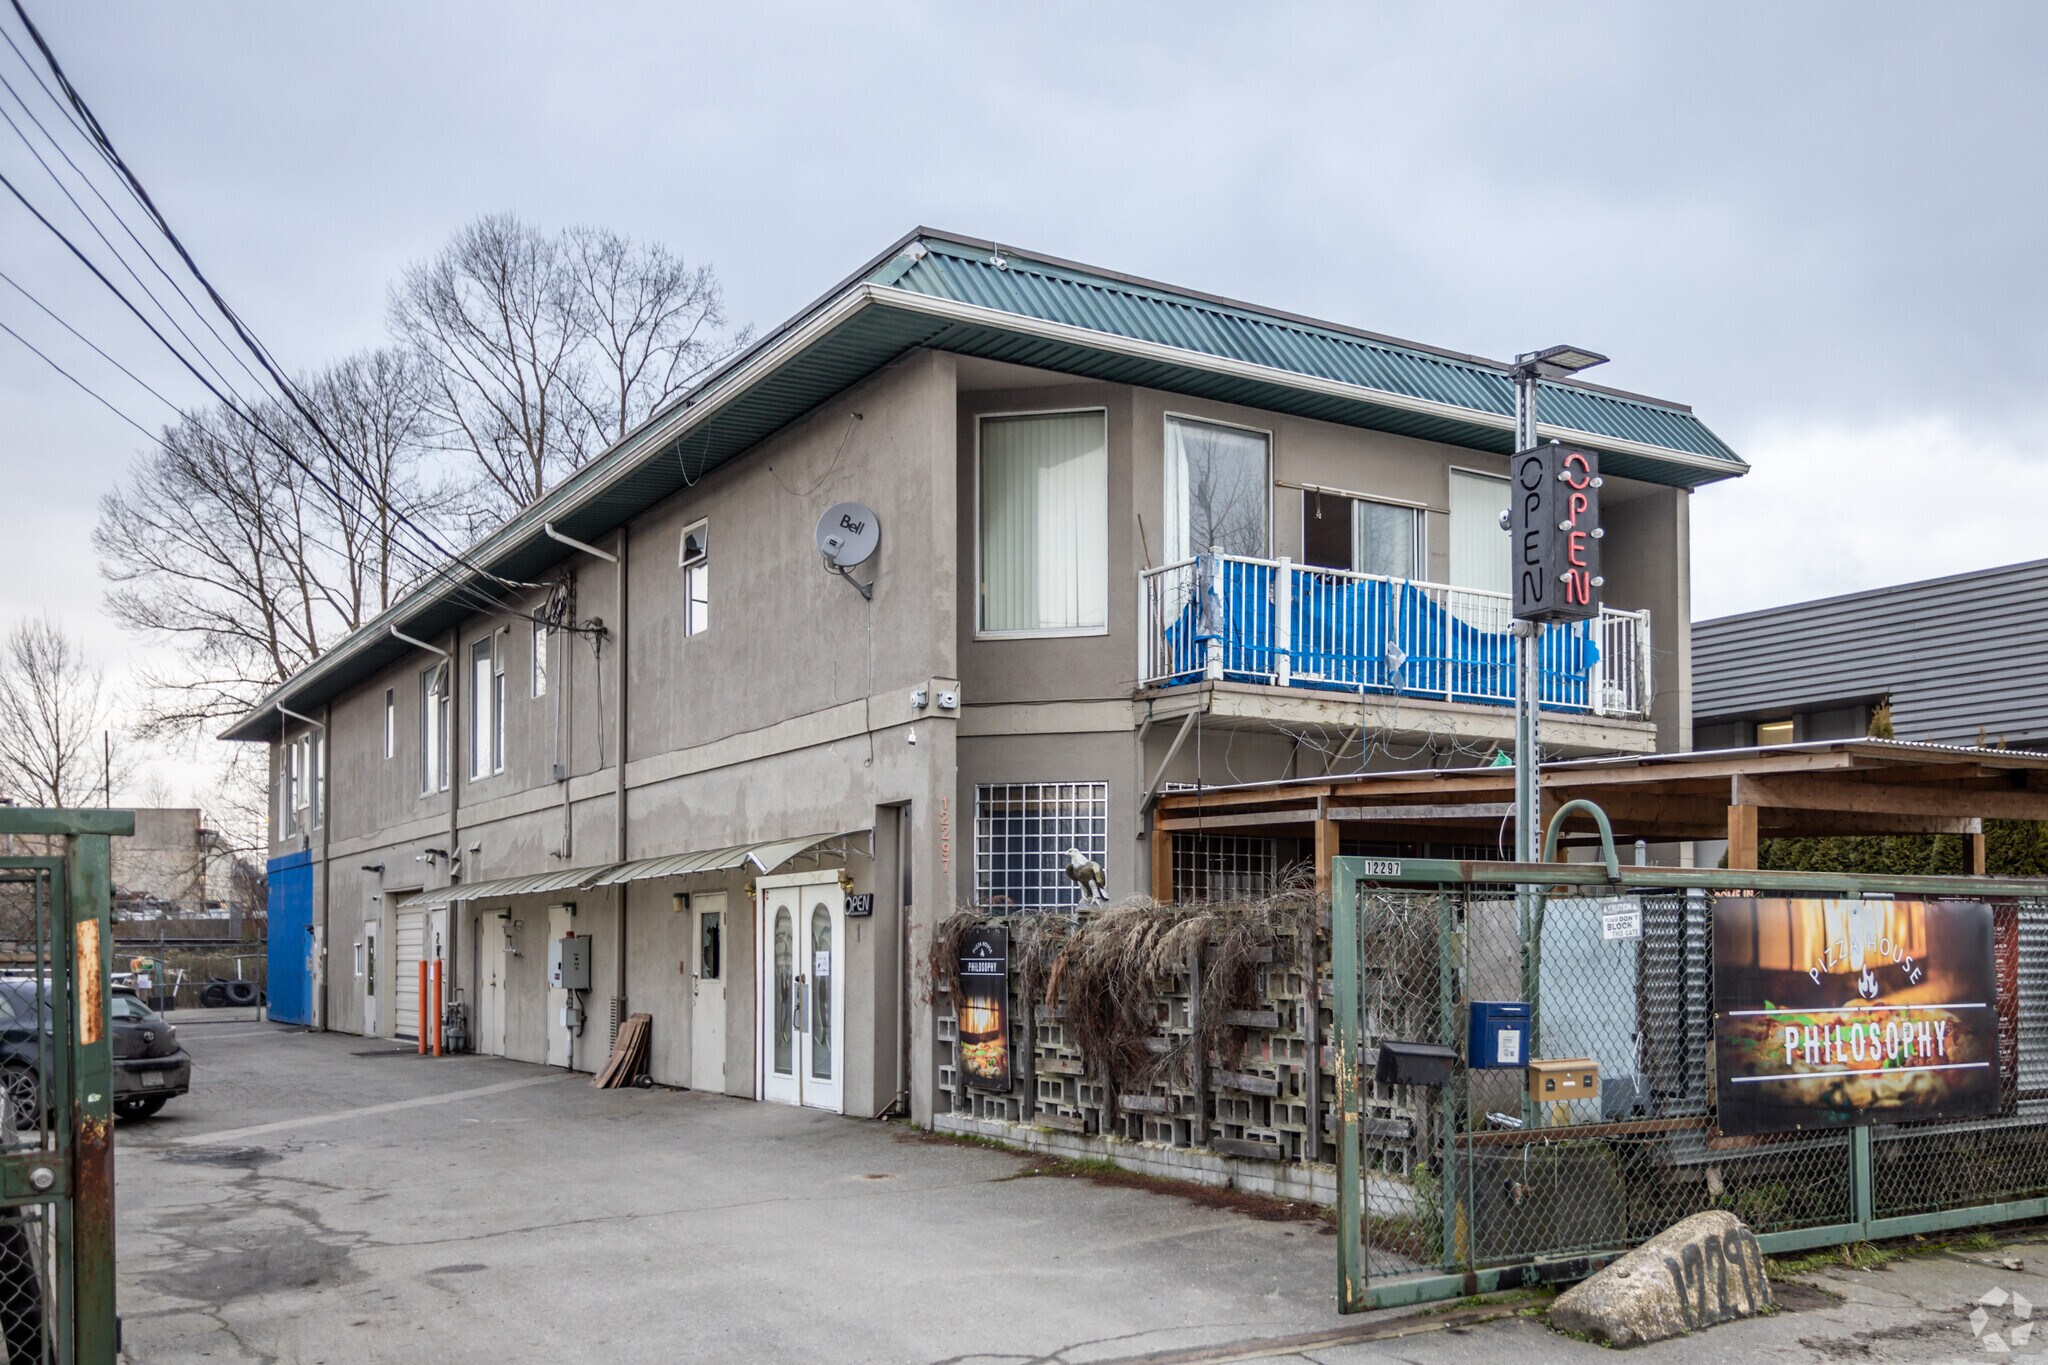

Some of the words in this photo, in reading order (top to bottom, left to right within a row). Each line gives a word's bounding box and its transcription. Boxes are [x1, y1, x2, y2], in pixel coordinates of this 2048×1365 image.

[839, 513, 866, 536] Bell
[1520, 456, 1543, 605] OPEN
[1563, 453, 1590, 605] OPEN
[940, 794, 950, 874] 12297
[1367, 861, 1400, 875] 12297
[844, 895, 870, 915] OPEN
[1607, 922, 1632, 931] BLOCK
[968, 962, 997, 972] PHILOSOPHY
[1809, 936, 1860, 986] PIZZA
[1866, 938, 1922, 985] HOUSE
[1785, 1020, 1946, 1065] PHILOSOPHY
[1663, 1227, 1770, 1331] 12297
